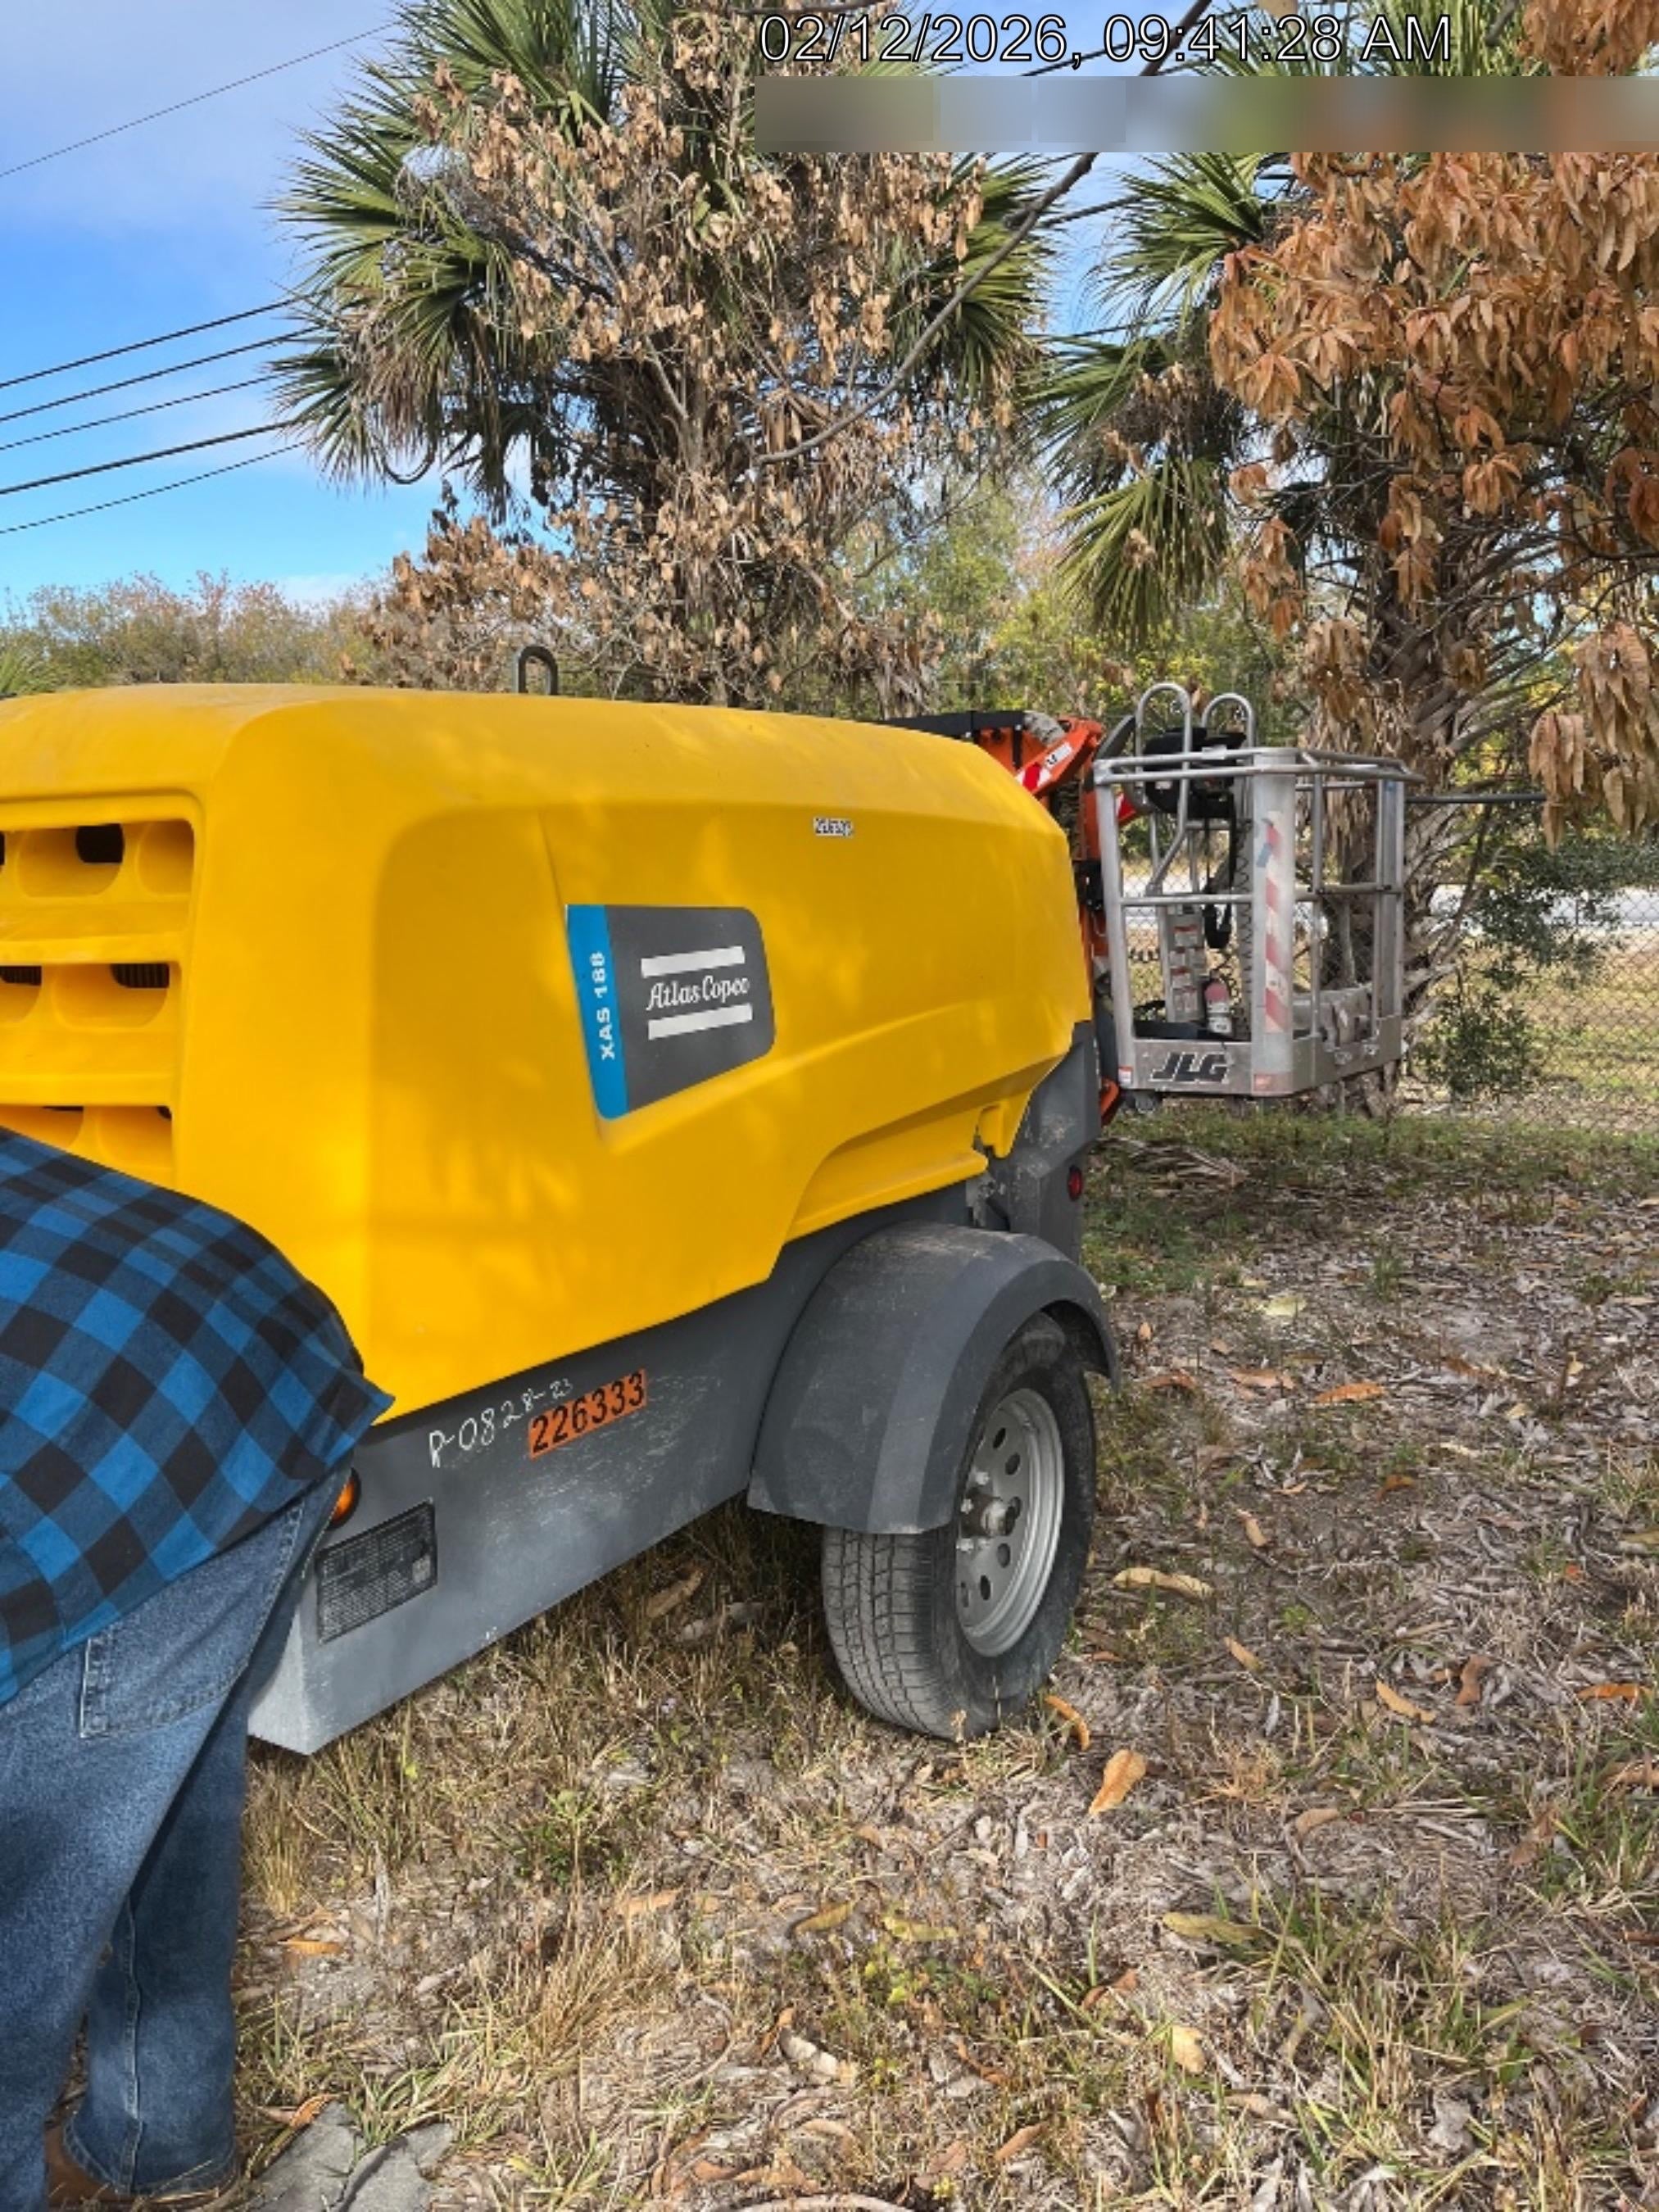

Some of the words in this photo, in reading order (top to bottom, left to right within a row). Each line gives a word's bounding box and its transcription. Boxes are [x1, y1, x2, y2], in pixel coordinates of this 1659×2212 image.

[589, 951, 607, 999] 188
[646, 981, 701, 1011] Atlas
[702, 975, 750, 1004] Copco
[596, 1007, 614, 1060] XAS
[1149, 1051, 1229, 1085] JLG
[532, 1370, 646, 1453] 226333
